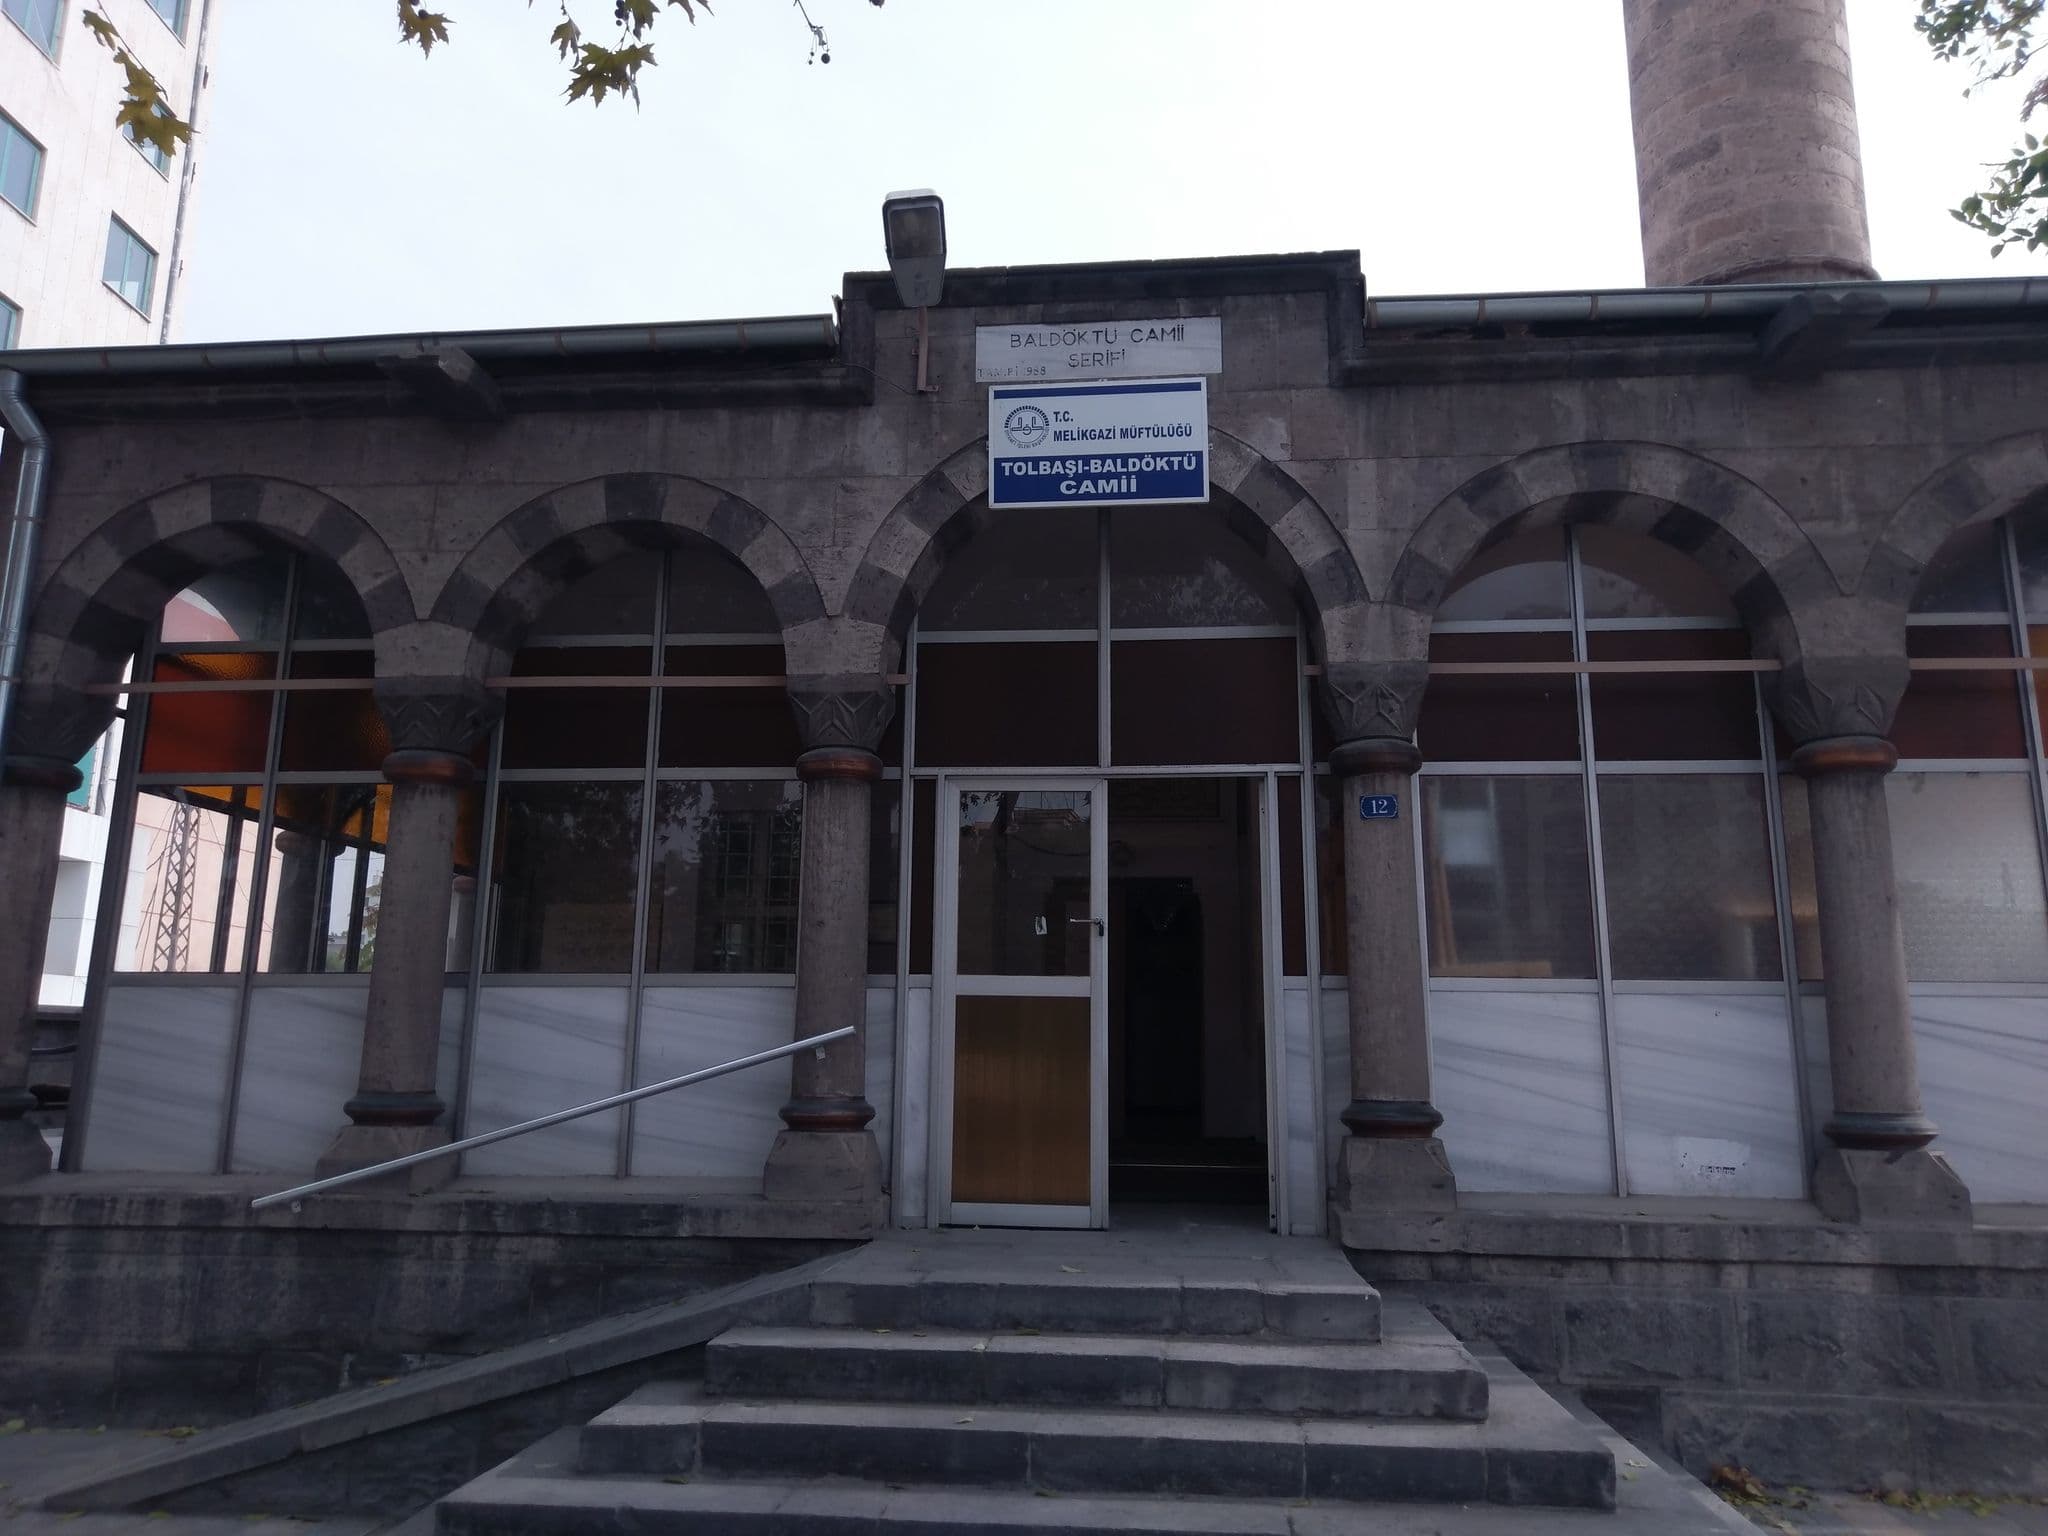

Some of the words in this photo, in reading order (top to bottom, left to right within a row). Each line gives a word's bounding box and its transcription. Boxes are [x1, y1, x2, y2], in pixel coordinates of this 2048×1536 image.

[1010, 327, 1118, 348] BALDÖKTÜ
[1130, 324, 1185, 344] CAMİİ
[1053, 411, 1074, 423] T.C.
[1053, 427, 1117, 442] MELİKGAZİ
[1120, 421, 1193, 440] MÜFTÜLÜĞÜ
[1001, 454, 1197, 478] TOLBAŞI-BALDÖKTÜ
[1060, 475, 1137, 495] CAMİİ
[1371, 799, 1388, 814] 12
